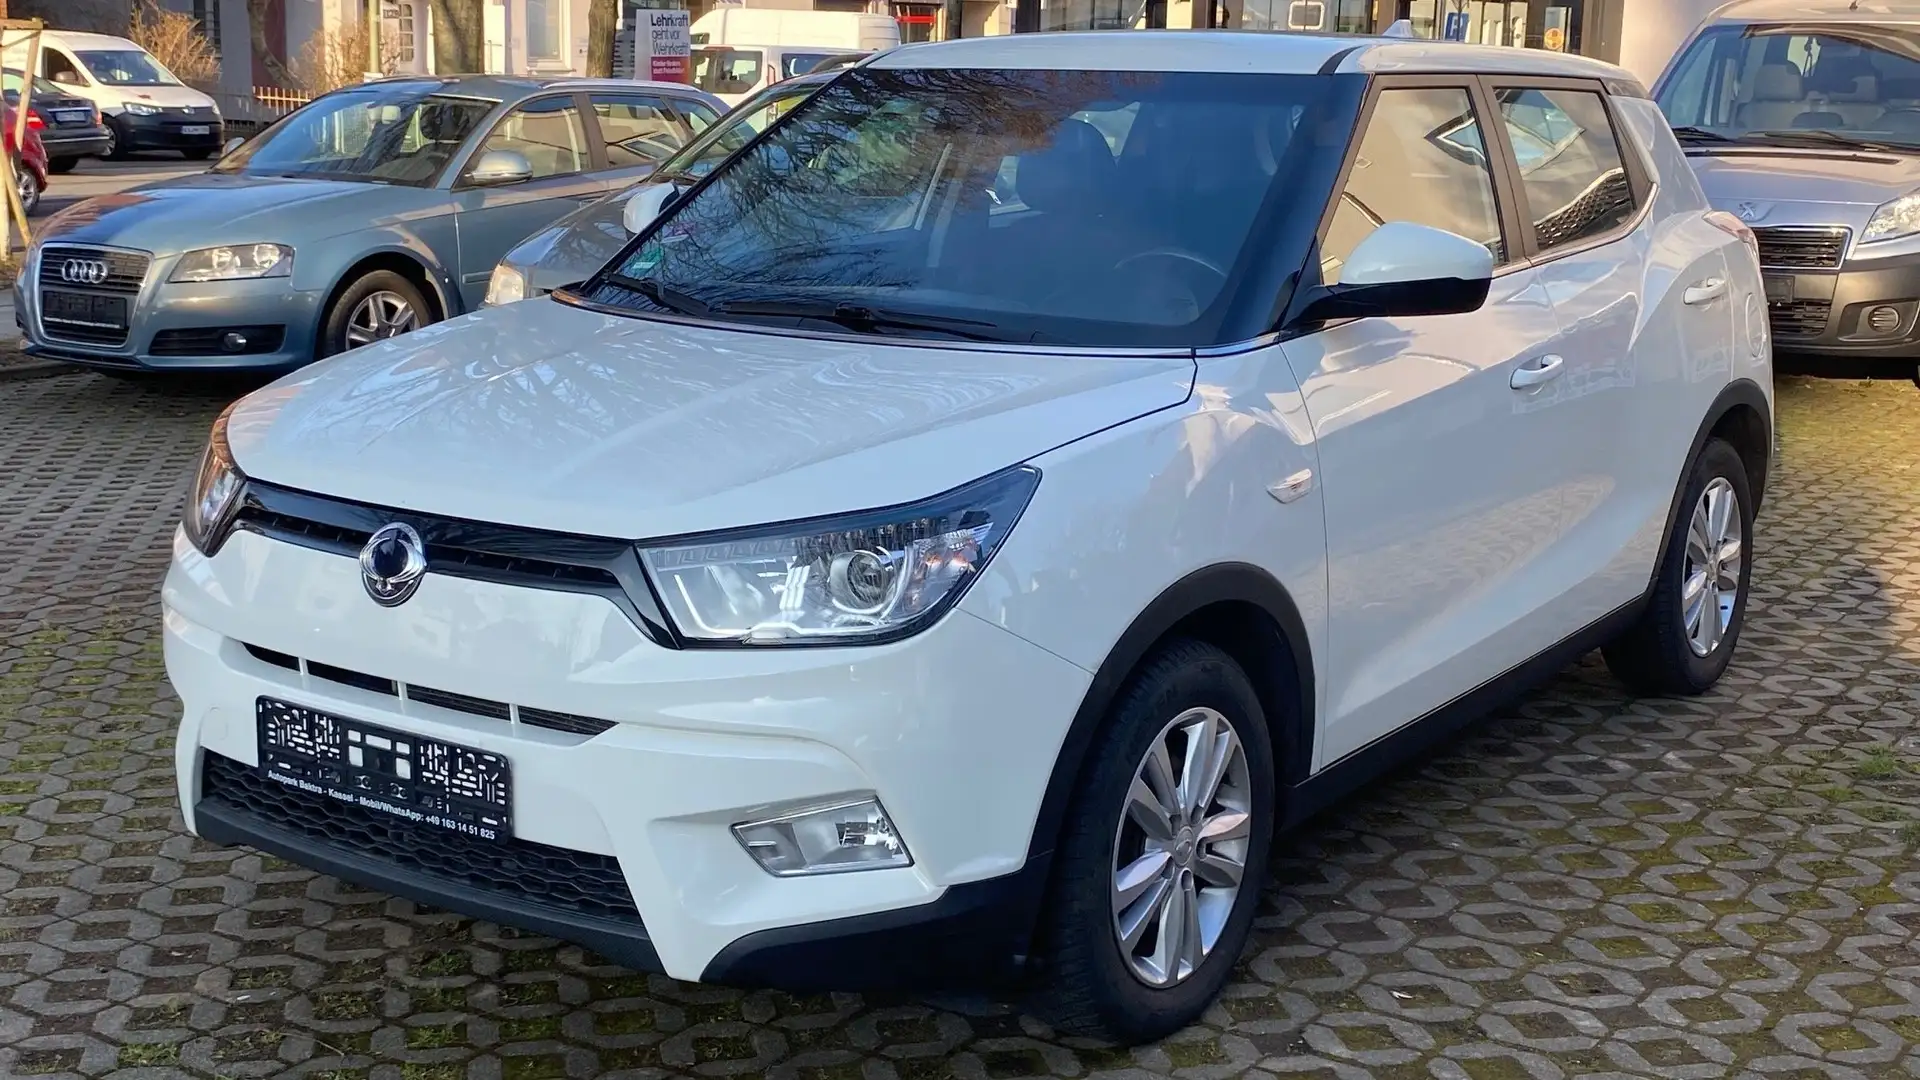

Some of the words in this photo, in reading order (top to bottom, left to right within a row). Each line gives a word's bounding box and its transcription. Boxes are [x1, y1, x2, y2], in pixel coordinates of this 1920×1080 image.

[651, 14, 688, 27] Lehrkraft
[652, 28, 669, 42] geht
[670, 30, 681, 40] vor
[653, 42, 689, 55] Wehrkraft
[268, 770, 298, 786] Autopark
[299, 780, 322, 794] Baktra
[328, 788, 353, 802] Kassel
[359, 796, 424, 822] Mobil/WhatsApp:
[426, 815, 440, 826] +49
[442, 818, 456, 830] 163
[457, 822, 467, 832] 14
[469, 825, 478, 836] 51
[480, 828, 495, 840] 825
